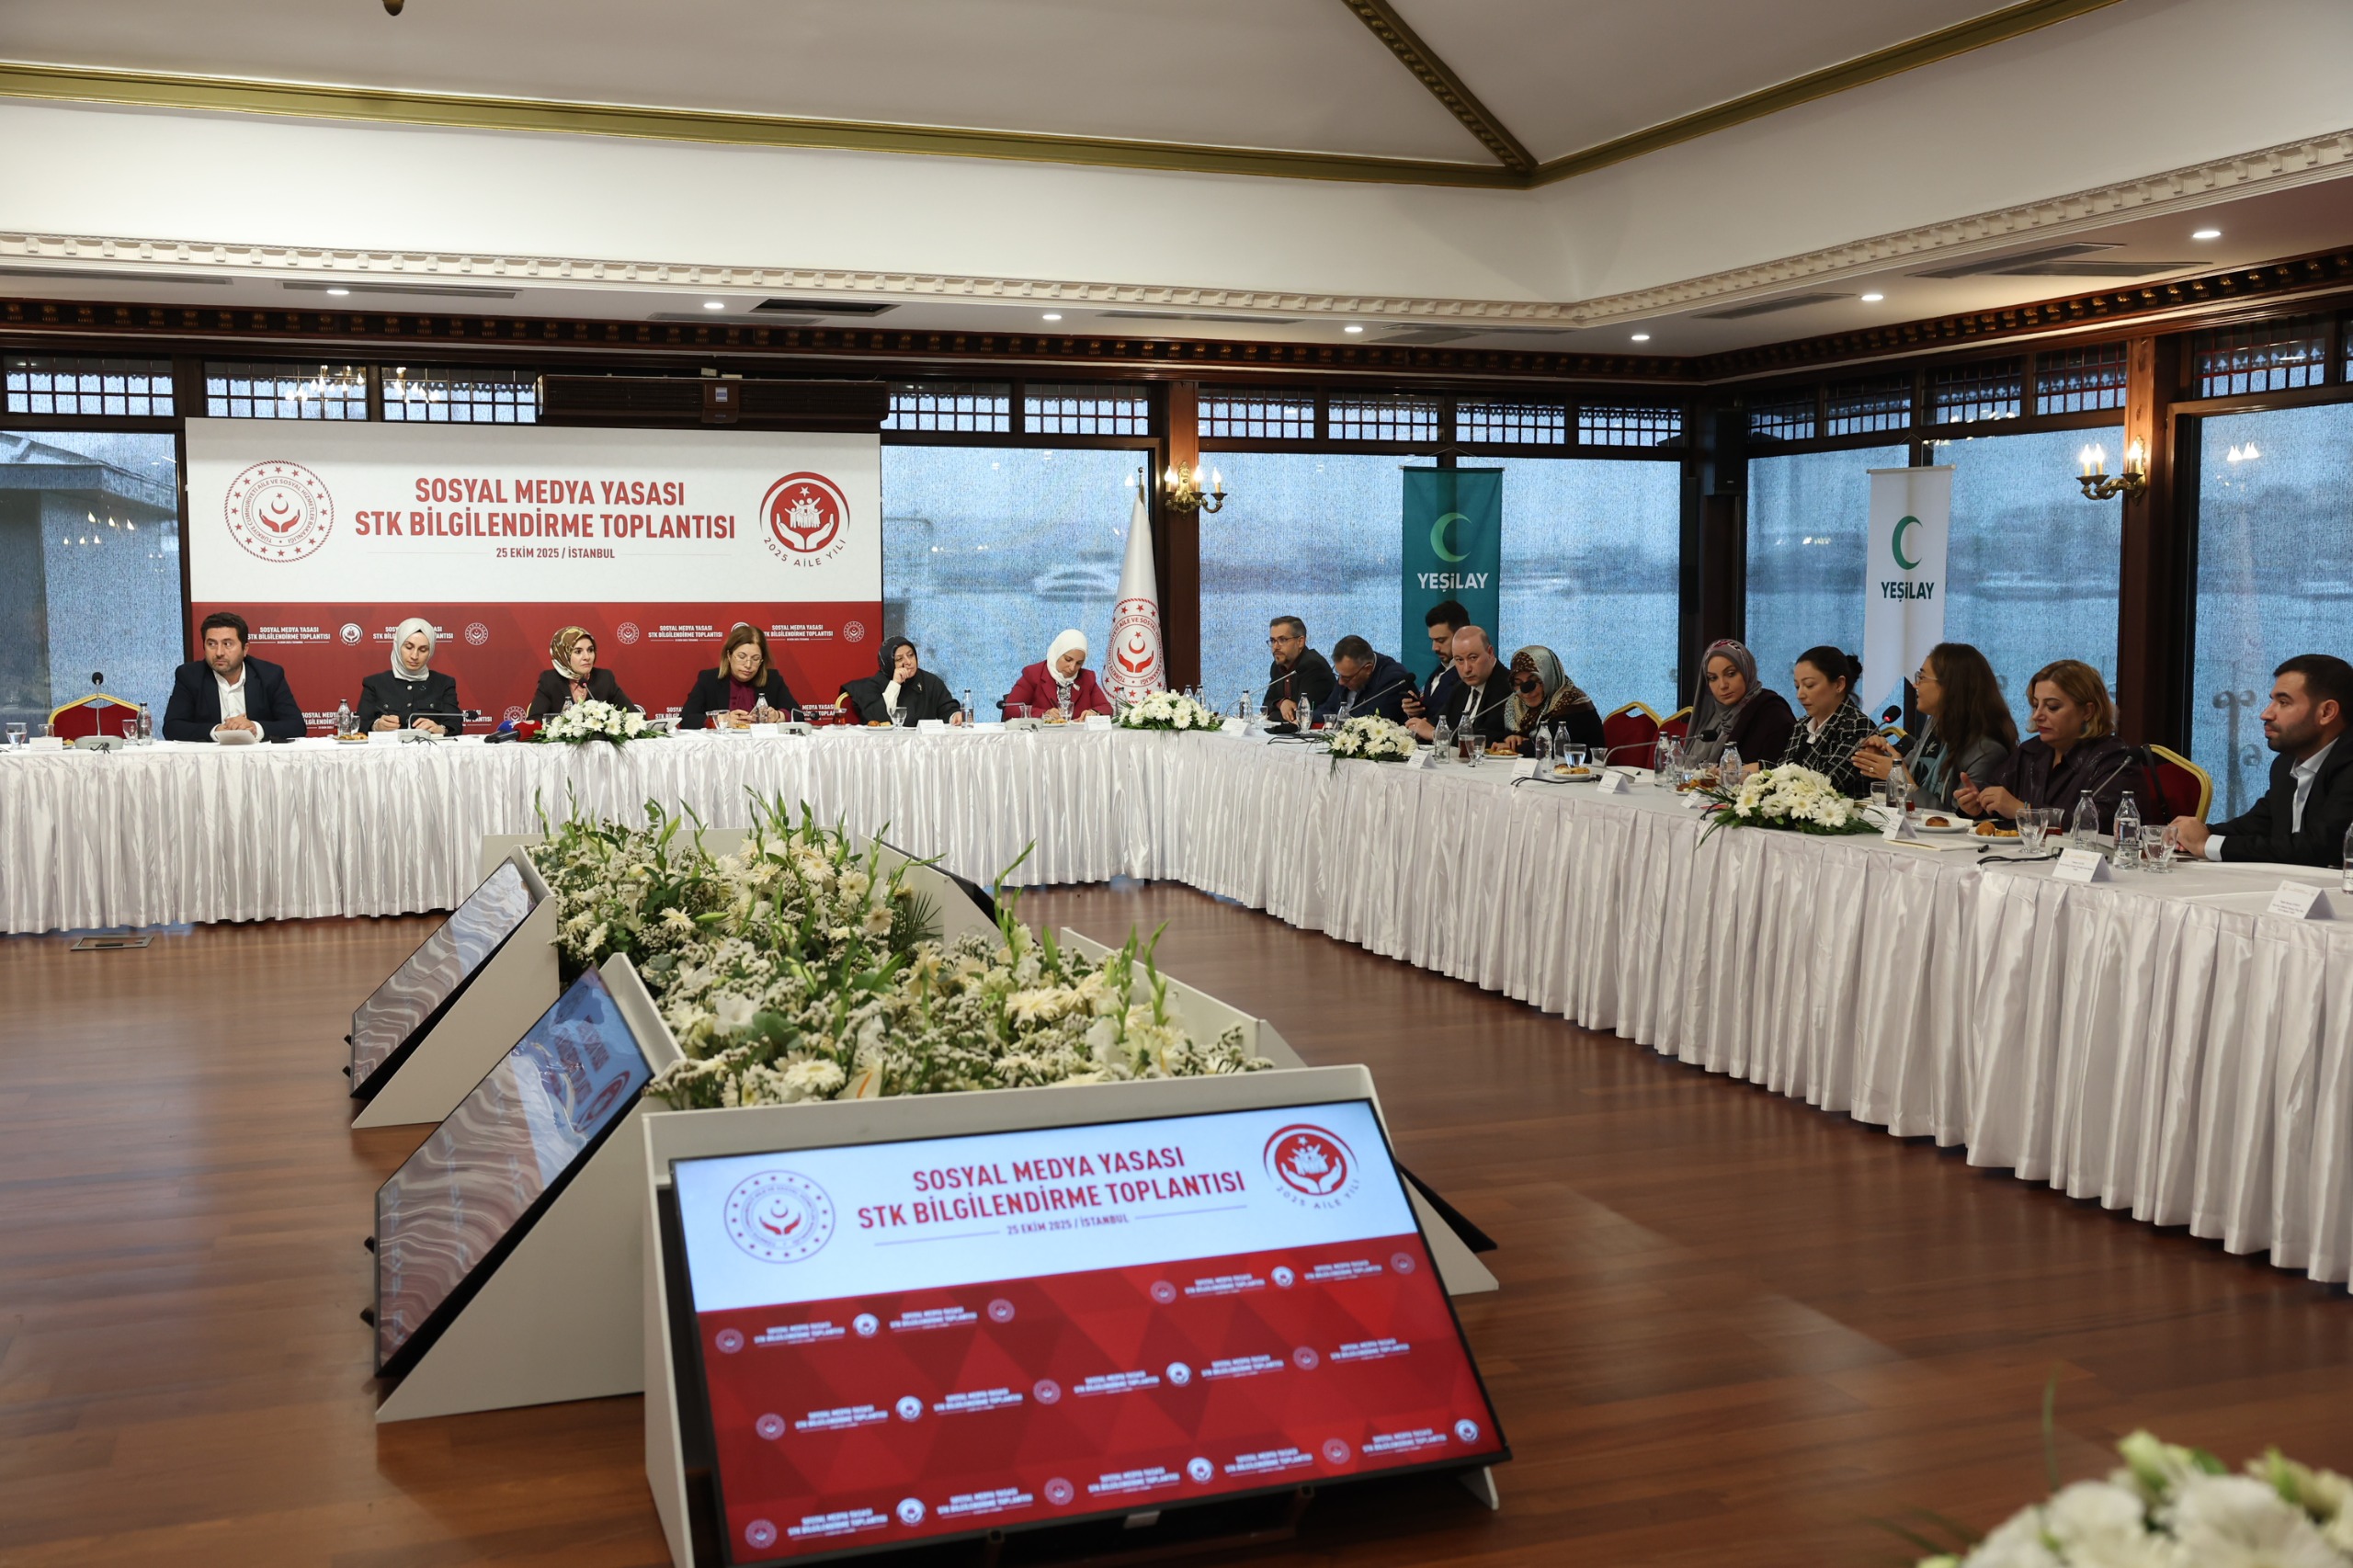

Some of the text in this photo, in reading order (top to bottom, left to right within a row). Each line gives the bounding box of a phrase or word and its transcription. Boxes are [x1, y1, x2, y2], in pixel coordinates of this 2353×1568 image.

[279, 478, 302, 491] SOSYAL
[415, 477, 684, 506] SOSYAL MEDYA YASASI
[355, 506, 734, 539] STK BİLGİLENDİRME TOPLANTISI
[496, 545, 615, 559] 25 EKİM 2025 / İSTANBUL
[763, 537, 847, 567] 2025 AİLE YILI
[1416, 572, 1489, 593] YEŞİLAY
[1881, 581, 1935, 603] YEŞİLAY
[913, 1146, 1186, 1192] SOSYAL MEDYA YASASI
[858, 1203, 907, 1229] STK
[913, 1184, 1102, 1223] BİLGİLENDİRME
[1105, 1170, 1245, 1204] TOPLANTISI
[1080, 1213, 1130, 1228] İSTANBUL
